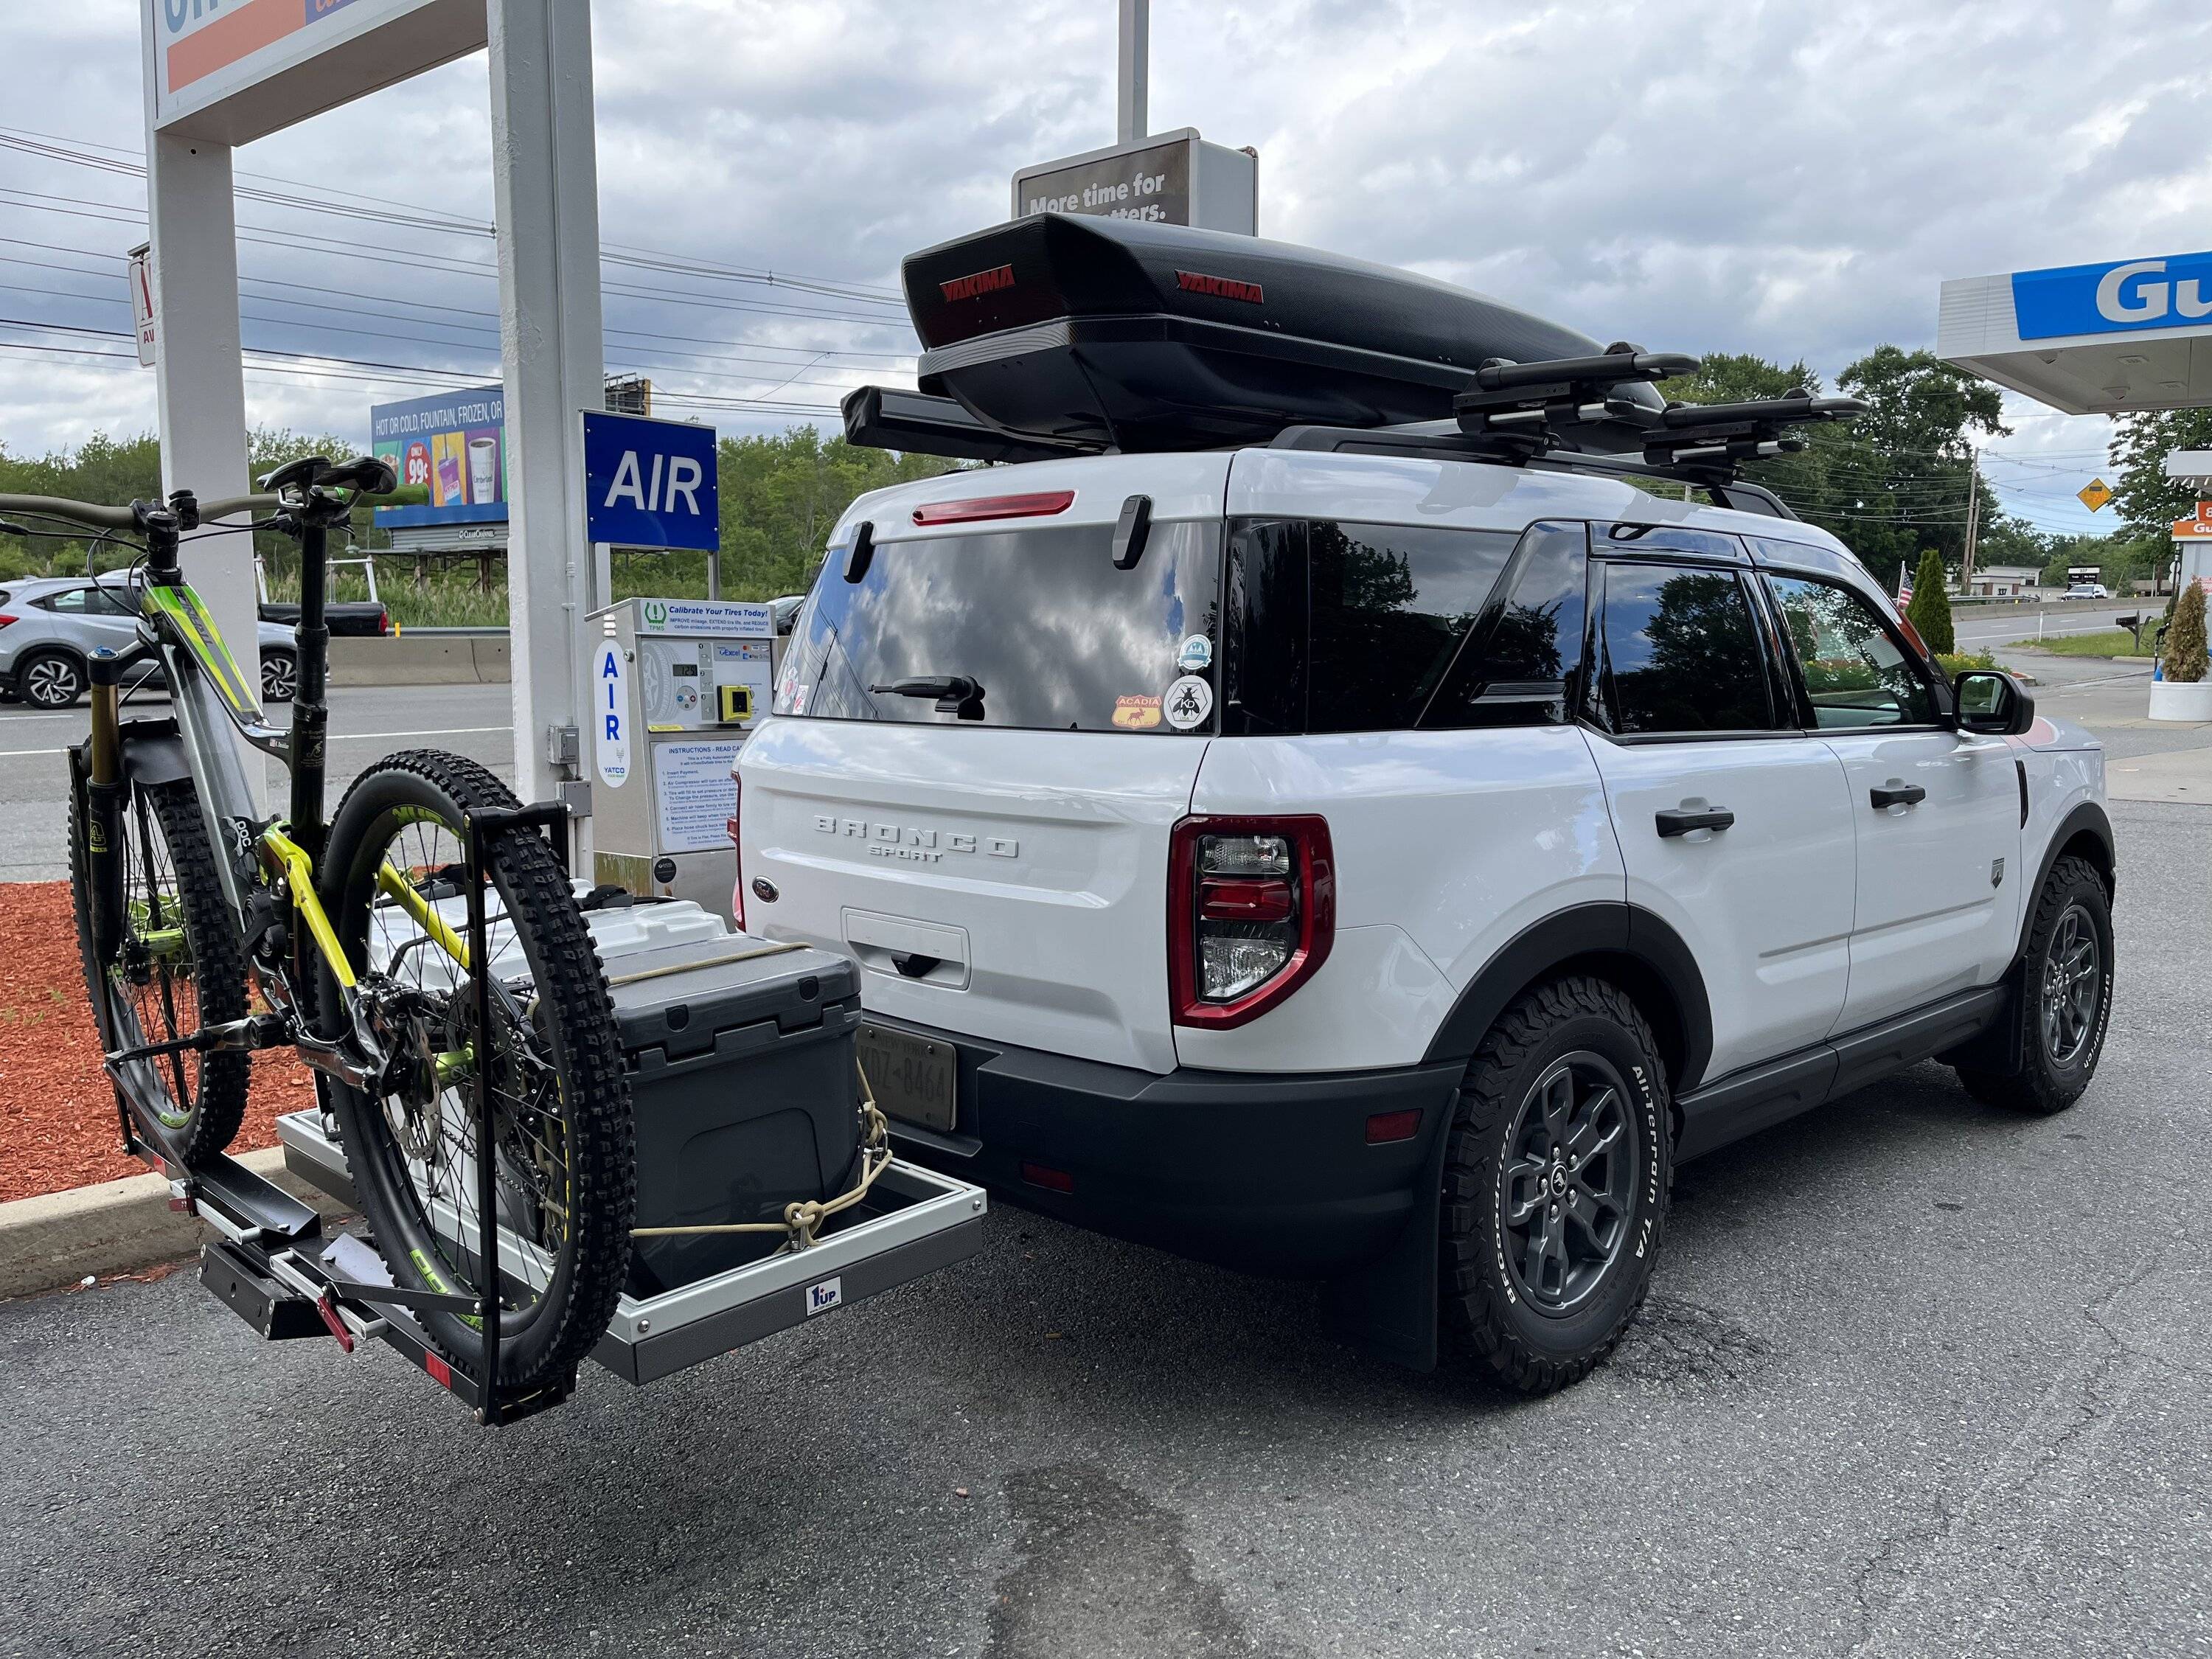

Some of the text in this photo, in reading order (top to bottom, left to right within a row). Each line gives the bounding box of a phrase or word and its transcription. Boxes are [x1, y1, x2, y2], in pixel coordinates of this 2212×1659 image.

[1031, 172, 1165, 214] More time for
[940, 263, 1015, 302] YAKIMA
[1175, 268, 1264, 304] YAKIMA
[376, 400, 503, 436] HOT OR COLD, FOUNTAIN, FROZEN, OR
[411, 446, 423, 457] ONLY
[604, 450, 702, 515] AIR
[669, 606, 703, 614] Calibrate
[744, 609, 768, 618] Today!
[602, 652, 620, 740] AIR
[1180, 699, 1195, 709] KD
[236, 821, 251, 847] POC
[814, 815, 1019, 858] BRONCO
[867, 845, 943, 862] SPORT
[2084, 973, 2110, 1068] BFGoodrich
[878, 1035, 899, 1051] NEW
[1632, 1066, 1658, 1259] All-Terrain T/A
[1495, 1121, 1517, 1304] BFGoodrich
[812, 1285, 836, 1307] 1UP
